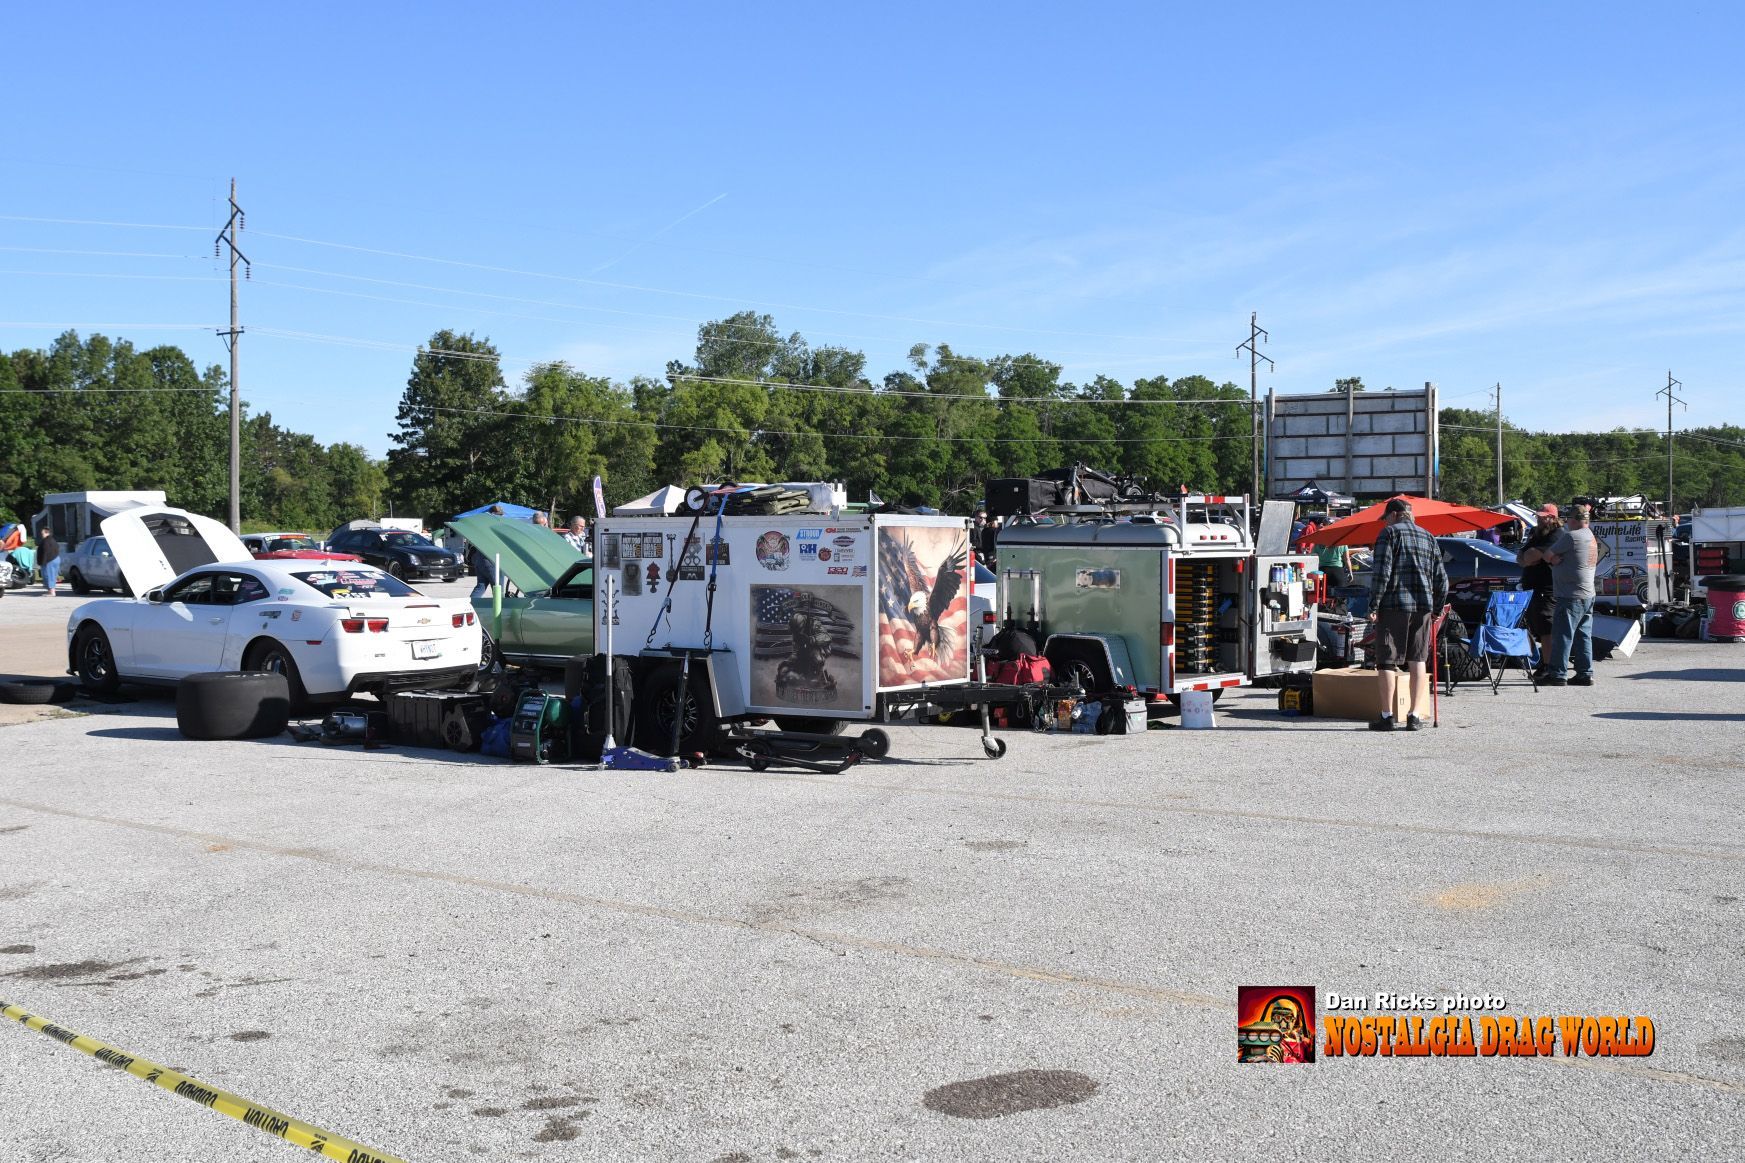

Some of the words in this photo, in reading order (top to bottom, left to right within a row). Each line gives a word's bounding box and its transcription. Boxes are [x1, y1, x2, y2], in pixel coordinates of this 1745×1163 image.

[1625, 536, 1647, 544] Racing
[174, 1080, 218, 1108] CUIDADO
[243, 1107, 288, 1138] CAUTION
